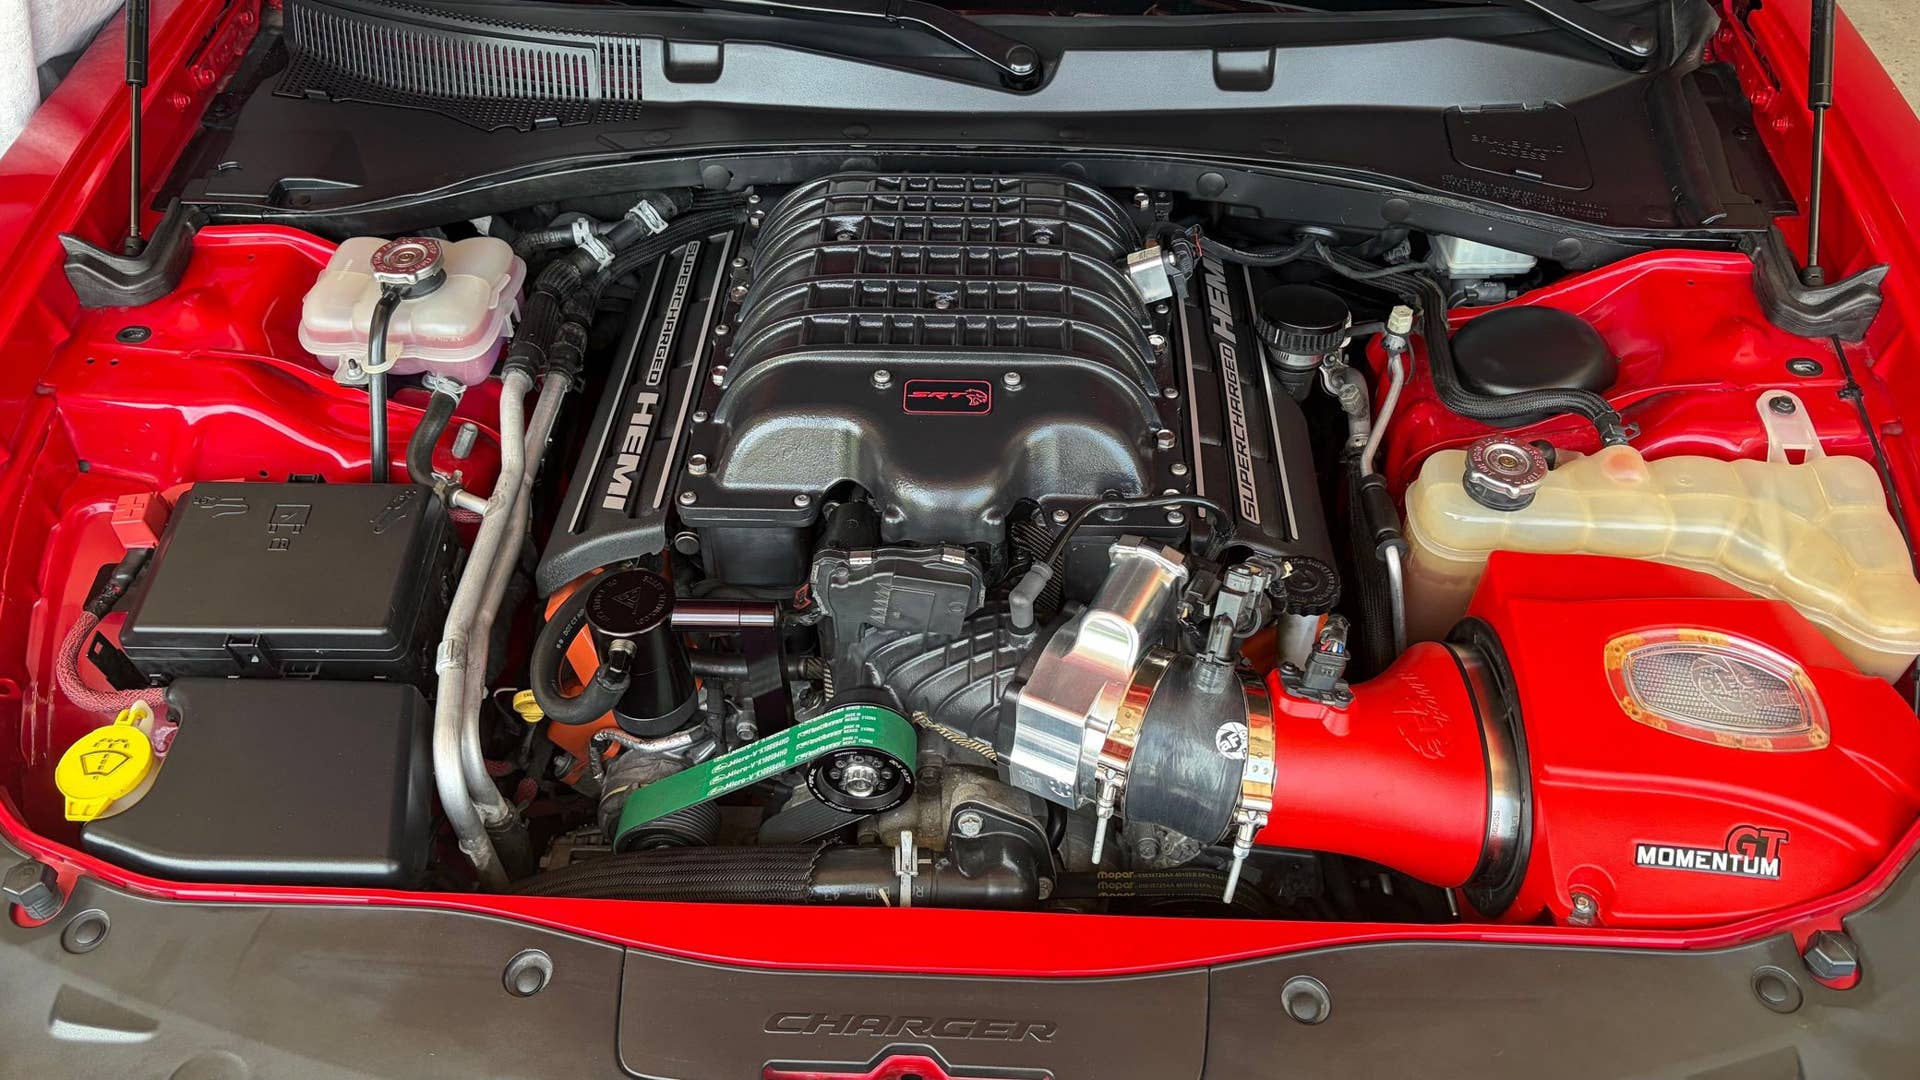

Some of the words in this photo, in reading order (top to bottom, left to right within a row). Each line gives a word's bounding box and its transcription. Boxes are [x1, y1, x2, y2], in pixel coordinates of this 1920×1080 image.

[648, 241, 699, 384] SUPERCHARGED
[908, 391, 967, 400] SRT
[1222, 346, 1259, 522] SUPERCHARGED
[602, 392, 660, 510] HEMI
[1727, 825, 1788, 862] GT
[1097, 871, 1135, 880] mopar
[1636, 845, 1780, 877] MOMENTUM
[1097, 881, 1134, 890] mopar
[763, 1011, 1059, 1042] CHARGER
